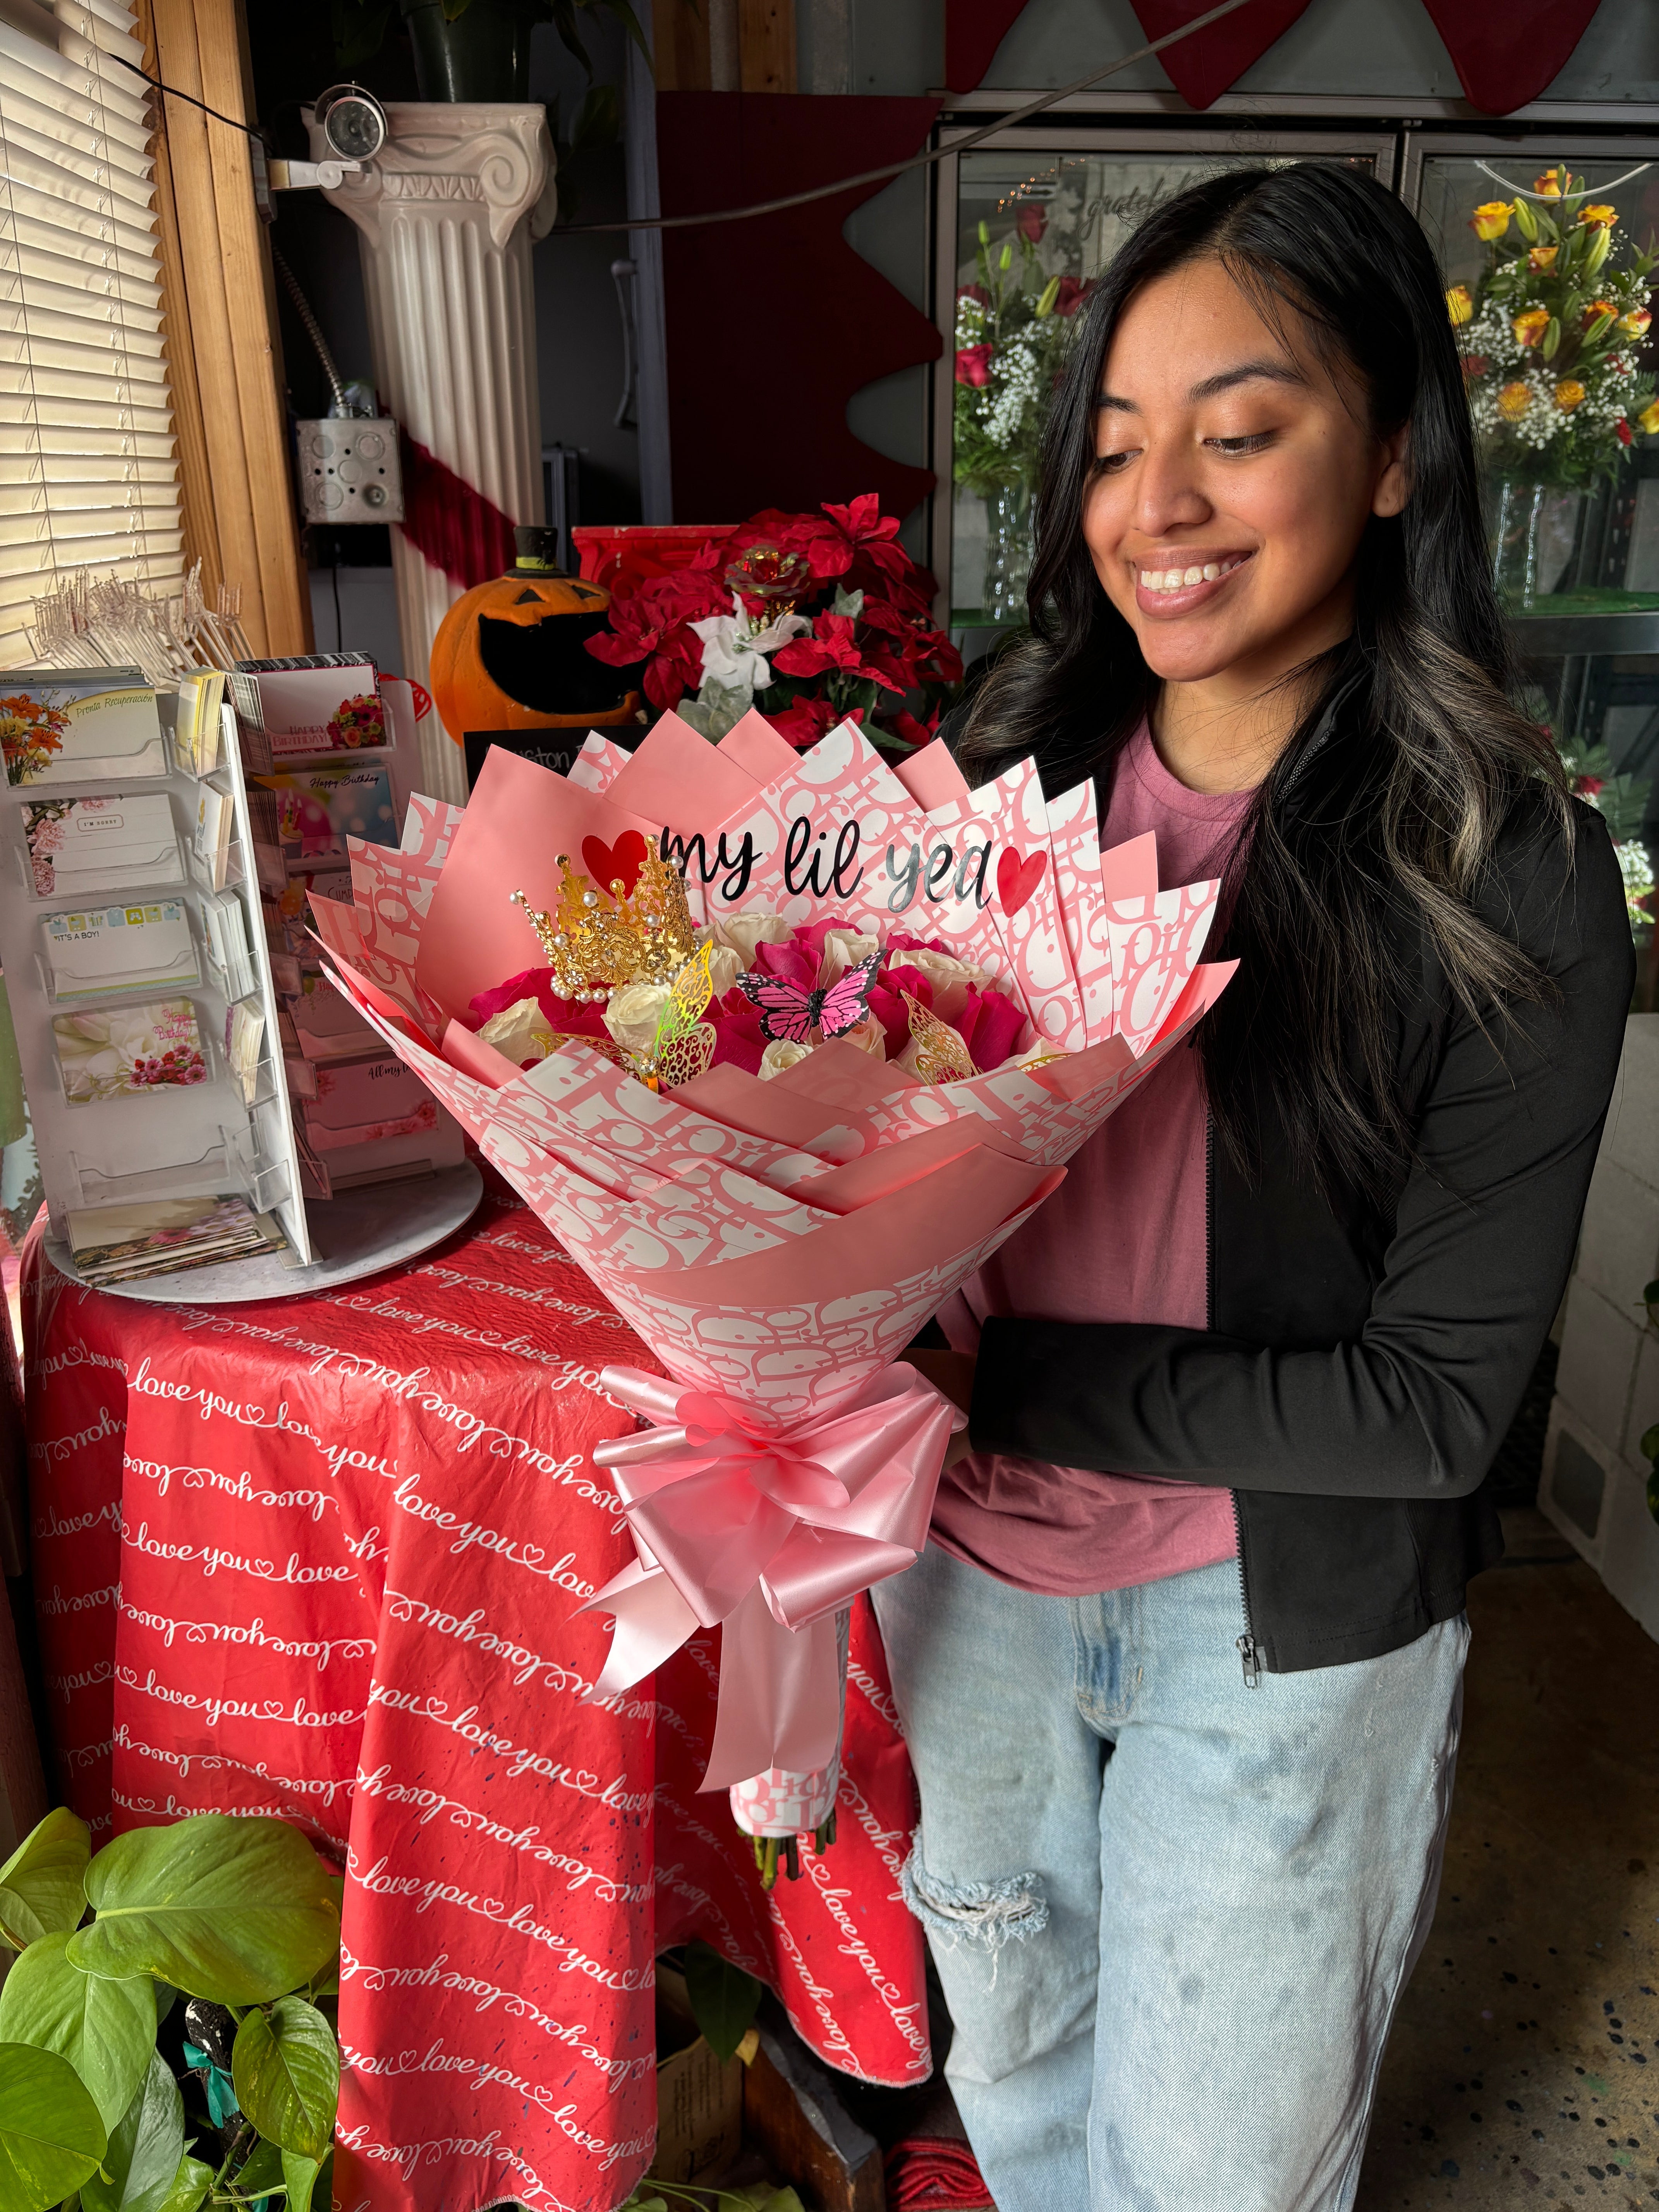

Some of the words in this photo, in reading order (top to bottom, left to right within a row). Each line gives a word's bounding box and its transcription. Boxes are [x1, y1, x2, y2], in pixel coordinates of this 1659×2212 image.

[76, 702, 101, 718] Pronta
[105, 694, 153, 708] Recuperación
[310, 777, 339, 789] Happy
[341, 774, 380, 785] Birthday
[660, 826, 763, 901] my
[785, 816, 864, 898] lil
[886, 840, 993, 914] yea
[81, 931, 100, 939] BOY!
[369, 1065, 384, 1080] All
[385, 1066, 401, 1077] my
